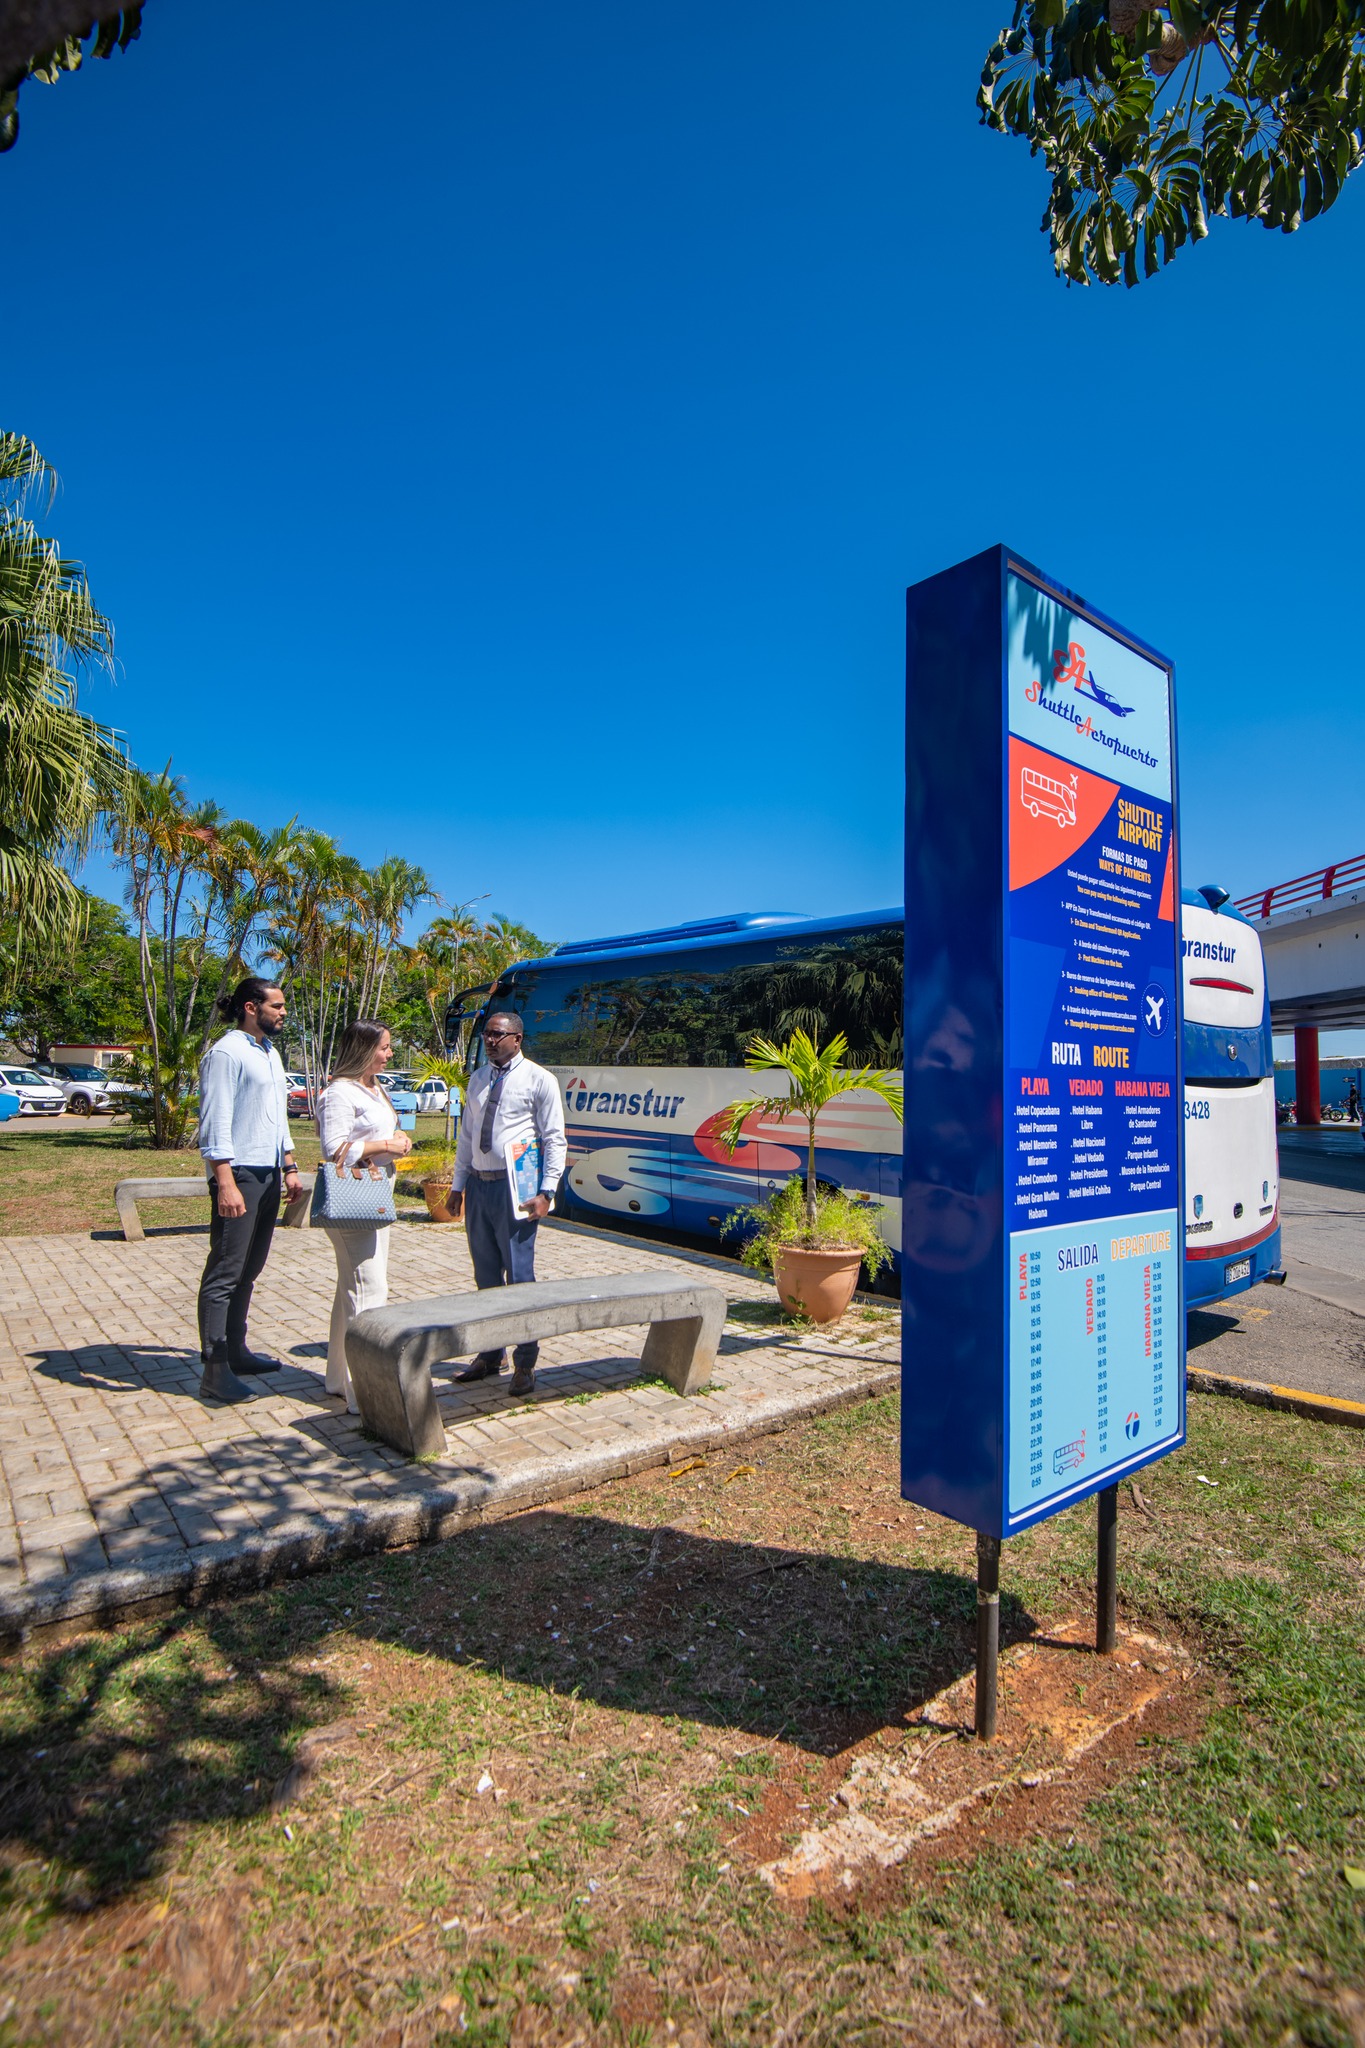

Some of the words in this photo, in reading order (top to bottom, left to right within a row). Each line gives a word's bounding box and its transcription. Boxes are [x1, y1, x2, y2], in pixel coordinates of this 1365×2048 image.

[1117, 798, 1163, 833] SHUTTLE
[1117, 817, 1162, 852] AIRPORT
[1102, 845, 1124, 862] FORMAS
[1133, 856, 1147, 870] PAGO
[1098, 858, 1114, 873] WAYS
[1123, 866, 1151, 884] PAYMENTS
[1051, 1041, 1081, 1065] RUTA
[1093, 1045, 1129, 1068] ROUTE
[1021, 1077, 1050, 1095] PLAYA
[1068, 1079, 1103, 1096] VEDADO
[1115, 1080, 1148, 1096] HABANA
[1148, 1081, 1170, 1097] VIEJA
[1016, 1105, 1030, 1115] Hotel
[1030, 1105, 1060, 1117] Copacabana
[1072, 1105, 1085, 1115] Hotel
[1085, 1105, 1102, 1115] Habana
[1125, 1105, 1137, 1114] Hotel
[1137, 1105, 1160, 1114] Armadores
[1018, 1122, 1032, 1133] Hotel
[1032, 1122, 1057, 1132] Panorama
[1081, 1119, 1093, 1129] Libre
[1134, 1118, 1157, 1128] Santander
[1019, 1139, 1033, 1151] Hotel
[1033, 1139, 1057, 1150] Memories
[1072, 1137, 1085, 1147] Hotel
[1085, 1136, 1105, 1147] Nacional
[1133, 1135, 1152, 1145] Catedral
[1027, 1155, 1048, 1166] Miramar
[1074, 1153, 1087, 1163] Hotel
[1086, 1152, 1104, 1162] Vedado
[1127, 1150, 1143, 1161] Parque
[1070, 1169, 1083, 1180] Hotel
[1083, 1168, 1108, 1179] Presidente
[1121, 1166, 1136, 1175] Museo
[1018, 1174, 1032, 1186] Hotel
[1032, 1172, 1057, 1184] Comodoro
[1130, 1182, 1145, 1192] Parque
[1144, 1179, 1161, 1190] Central
[1016, 1193, 1030, 1205] Hotel
[1031, 1192, 1043, 1203] Gran
[1068, 1187, 1081, 1198] Hotel
[1028, 1208, 1047, 1219] Habana
[1058, 1244, 1098, 1271] SALIDA
[1111, 1230, 1170, 1261] DEPARTURE
[1019, 1253, 1027, 1300] PLAYA
[1143, 1265, 1151, 1300] VIEJA
[1085, 1278, 1094, 1335] VEDADO
